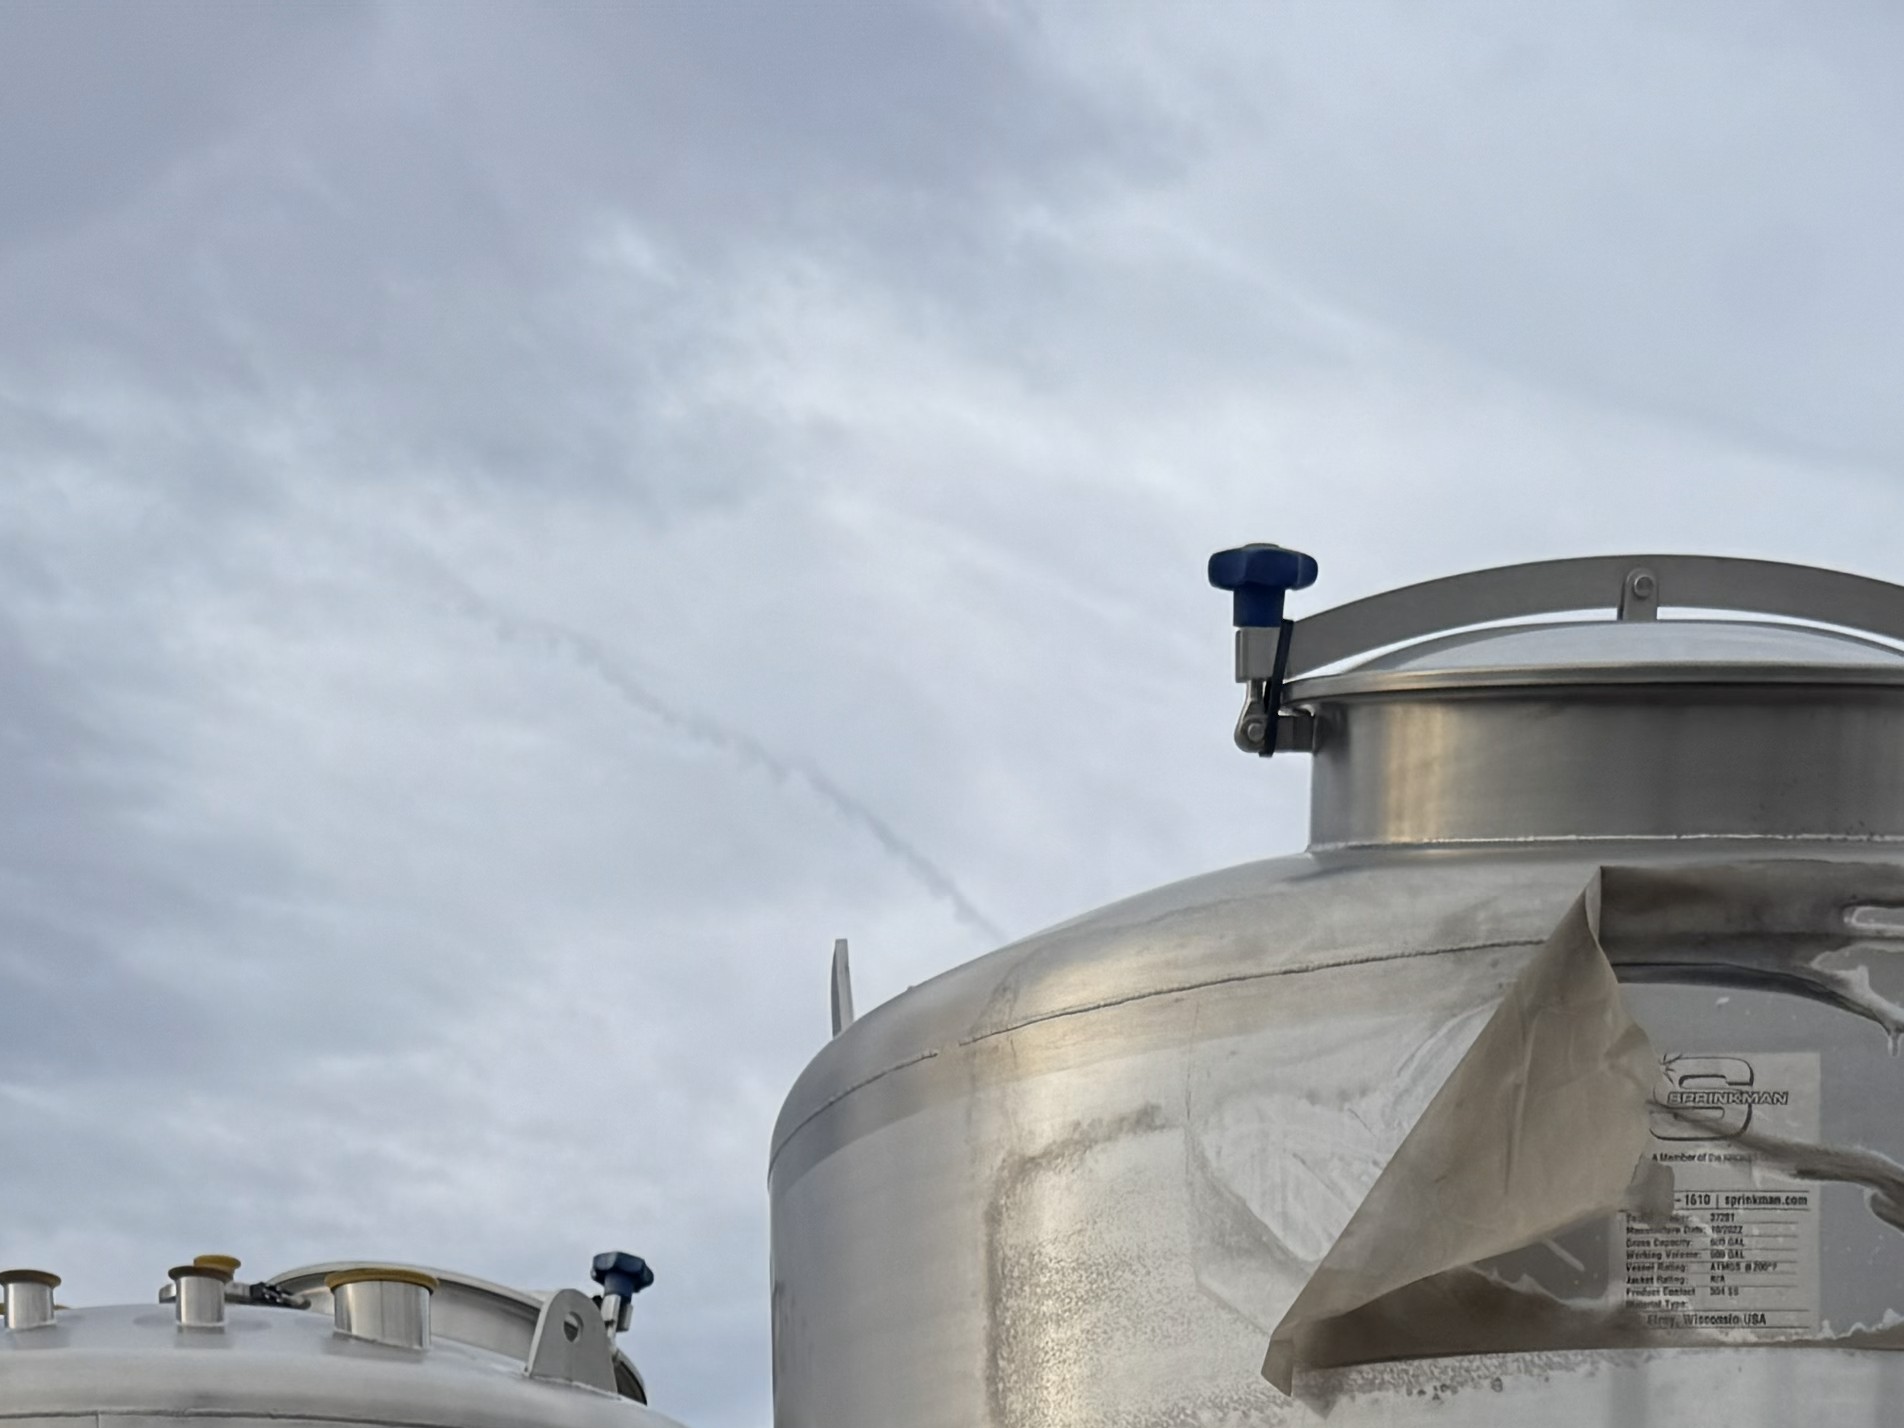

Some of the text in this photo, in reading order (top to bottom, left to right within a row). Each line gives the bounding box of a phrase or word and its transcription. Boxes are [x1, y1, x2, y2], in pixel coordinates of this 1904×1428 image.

[1667, 1090, 1789, 1105] SPRINKMAN
[1685, 1194, 1711, 1206] 1610
[1724, 1194, 1808, 1208] sprinkman.com
[1683, 1313, 1739, 1326] Wisconsin
[1743, 1313, 1767, 1326] USA
